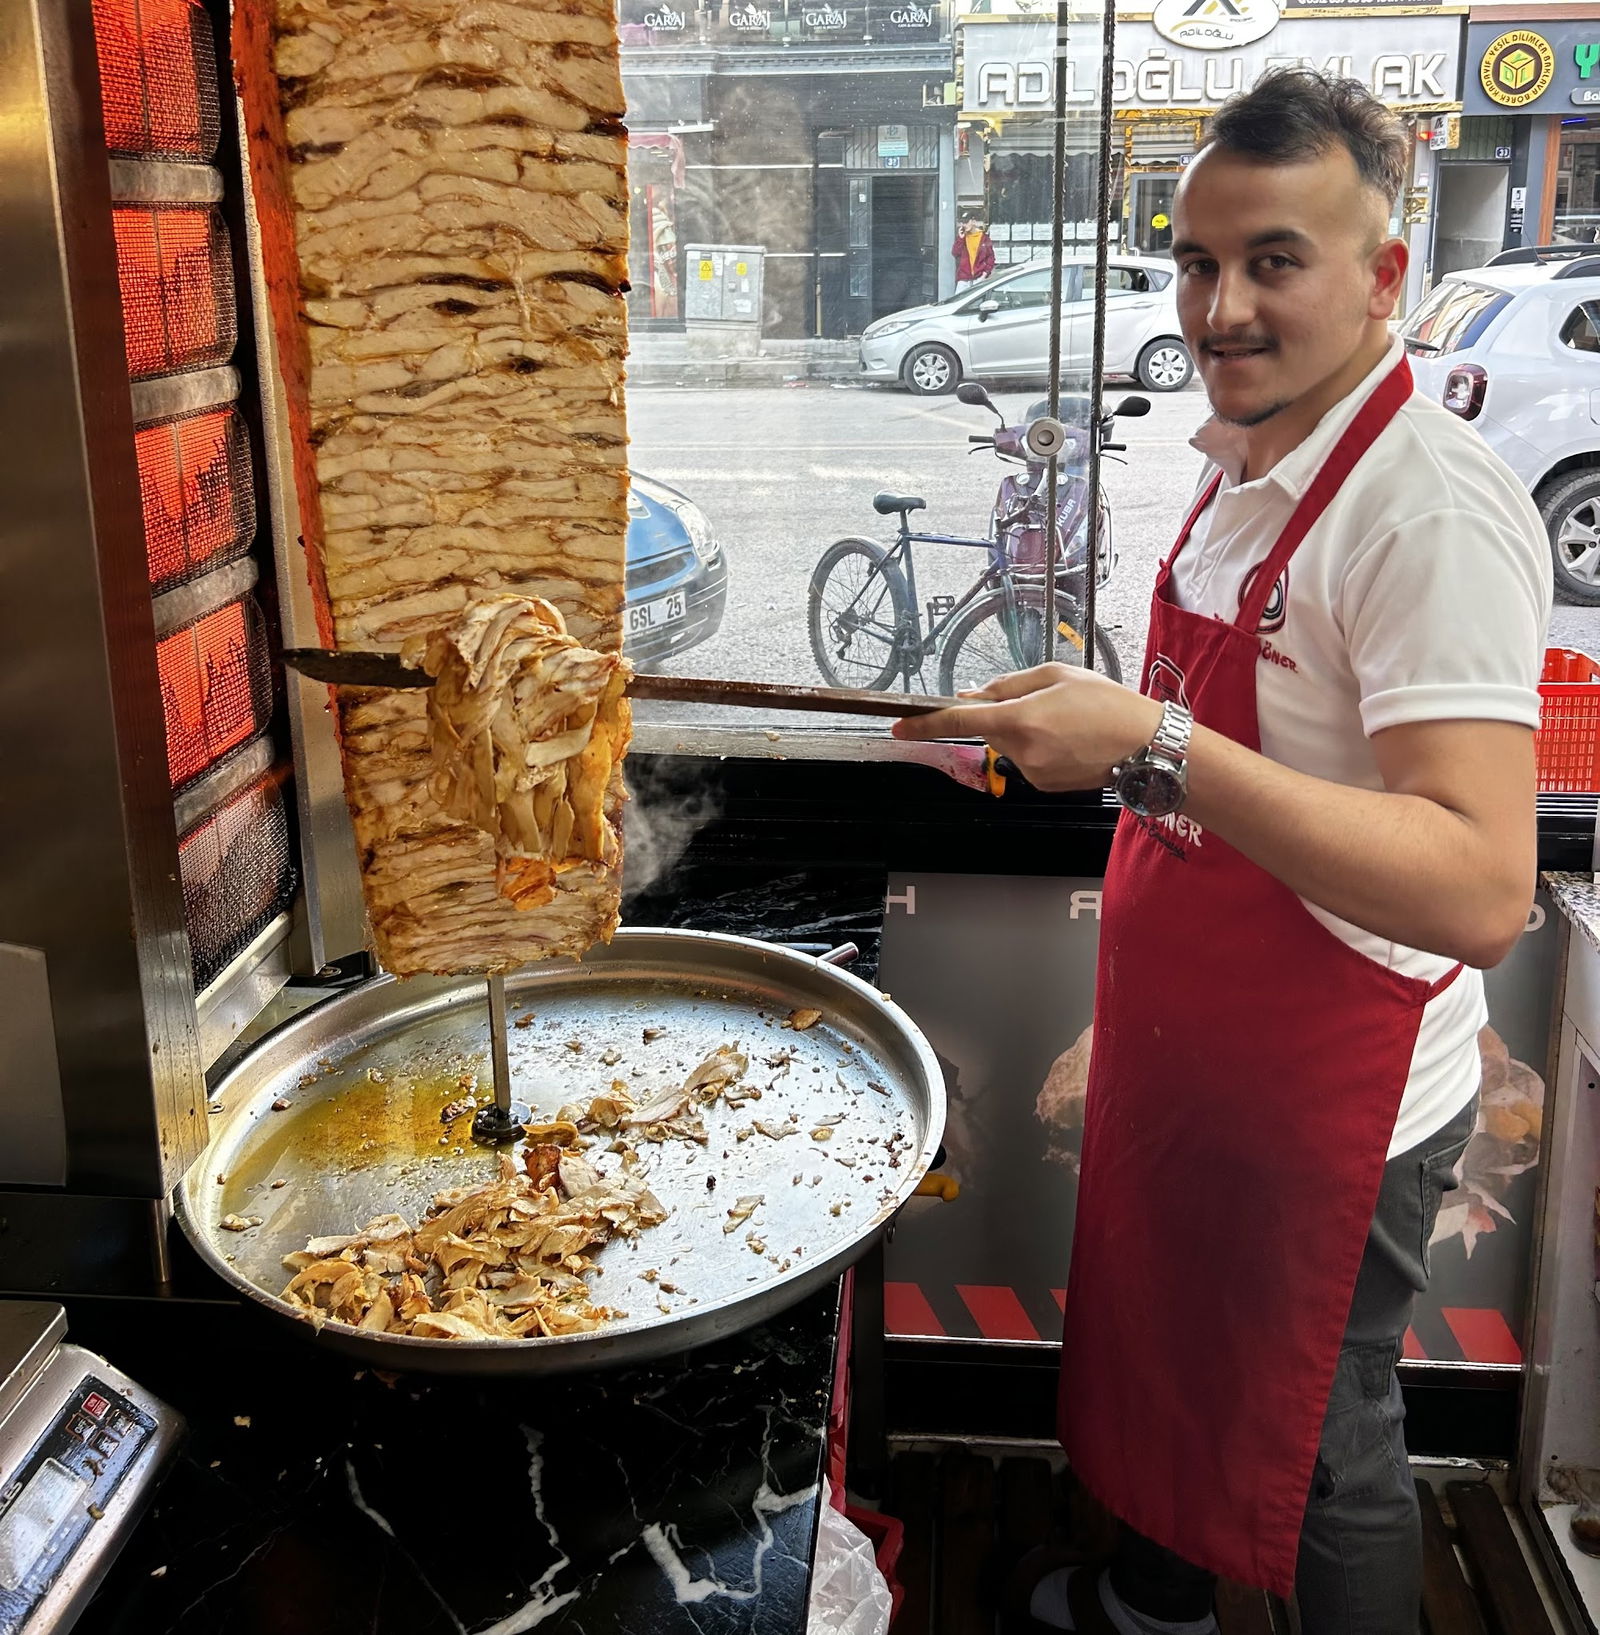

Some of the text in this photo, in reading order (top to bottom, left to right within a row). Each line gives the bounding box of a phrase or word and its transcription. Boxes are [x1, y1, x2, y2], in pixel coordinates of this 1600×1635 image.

[644, 11, 685, 30] GARAJ
[729, 10, 770, 30] GARAJ
[805, 10, 847, 29] GARAJ
[890, 9, 931, 28] GARAJ
[979, 48, 1242, 104] ADLOĞLU
[1583, 91, 1600, 101] Ba
[1056, 498, 1077, 527] KUBA
[629, 595, 682, 630] GSL 25
[1262, 640, 1298, 674] ÖNER
